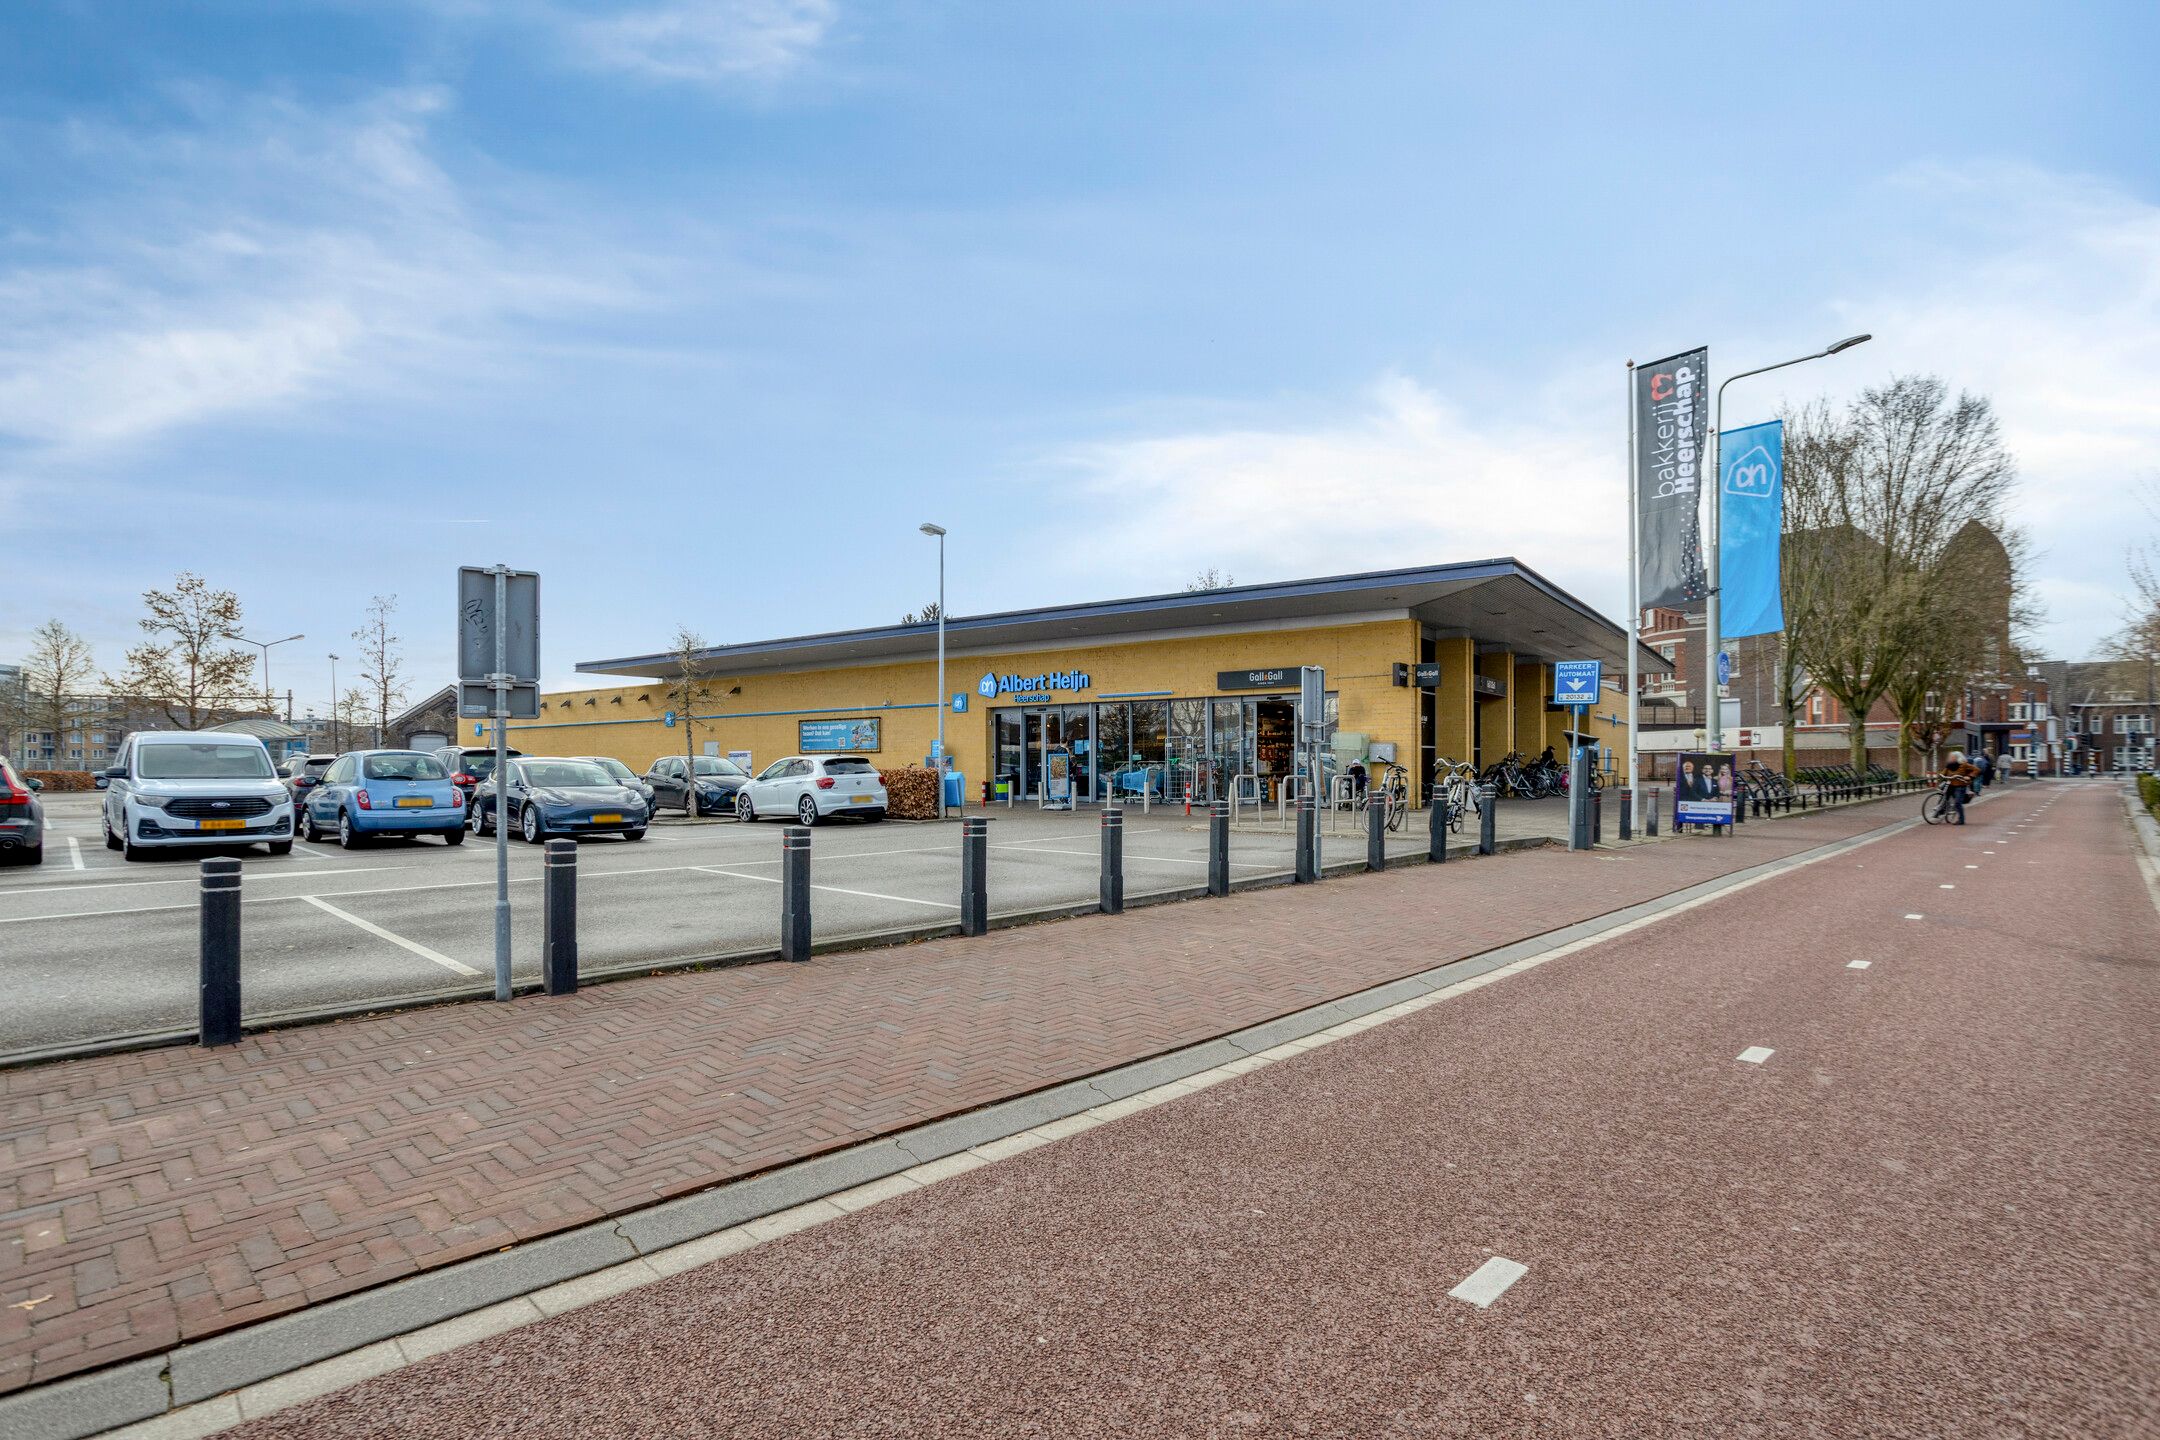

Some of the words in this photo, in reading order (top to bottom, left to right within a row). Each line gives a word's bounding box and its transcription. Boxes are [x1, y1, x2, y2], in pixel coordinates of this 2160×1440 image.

[1651, 402, 1679, 499] bakkerij
[1674, 367, 1696, 494] Heerschap
[999, 674, 1046, 693] Albert
[1049, 670, 1089, 692] Heijn
[1014, 694, 1050, 703] Heerschap
